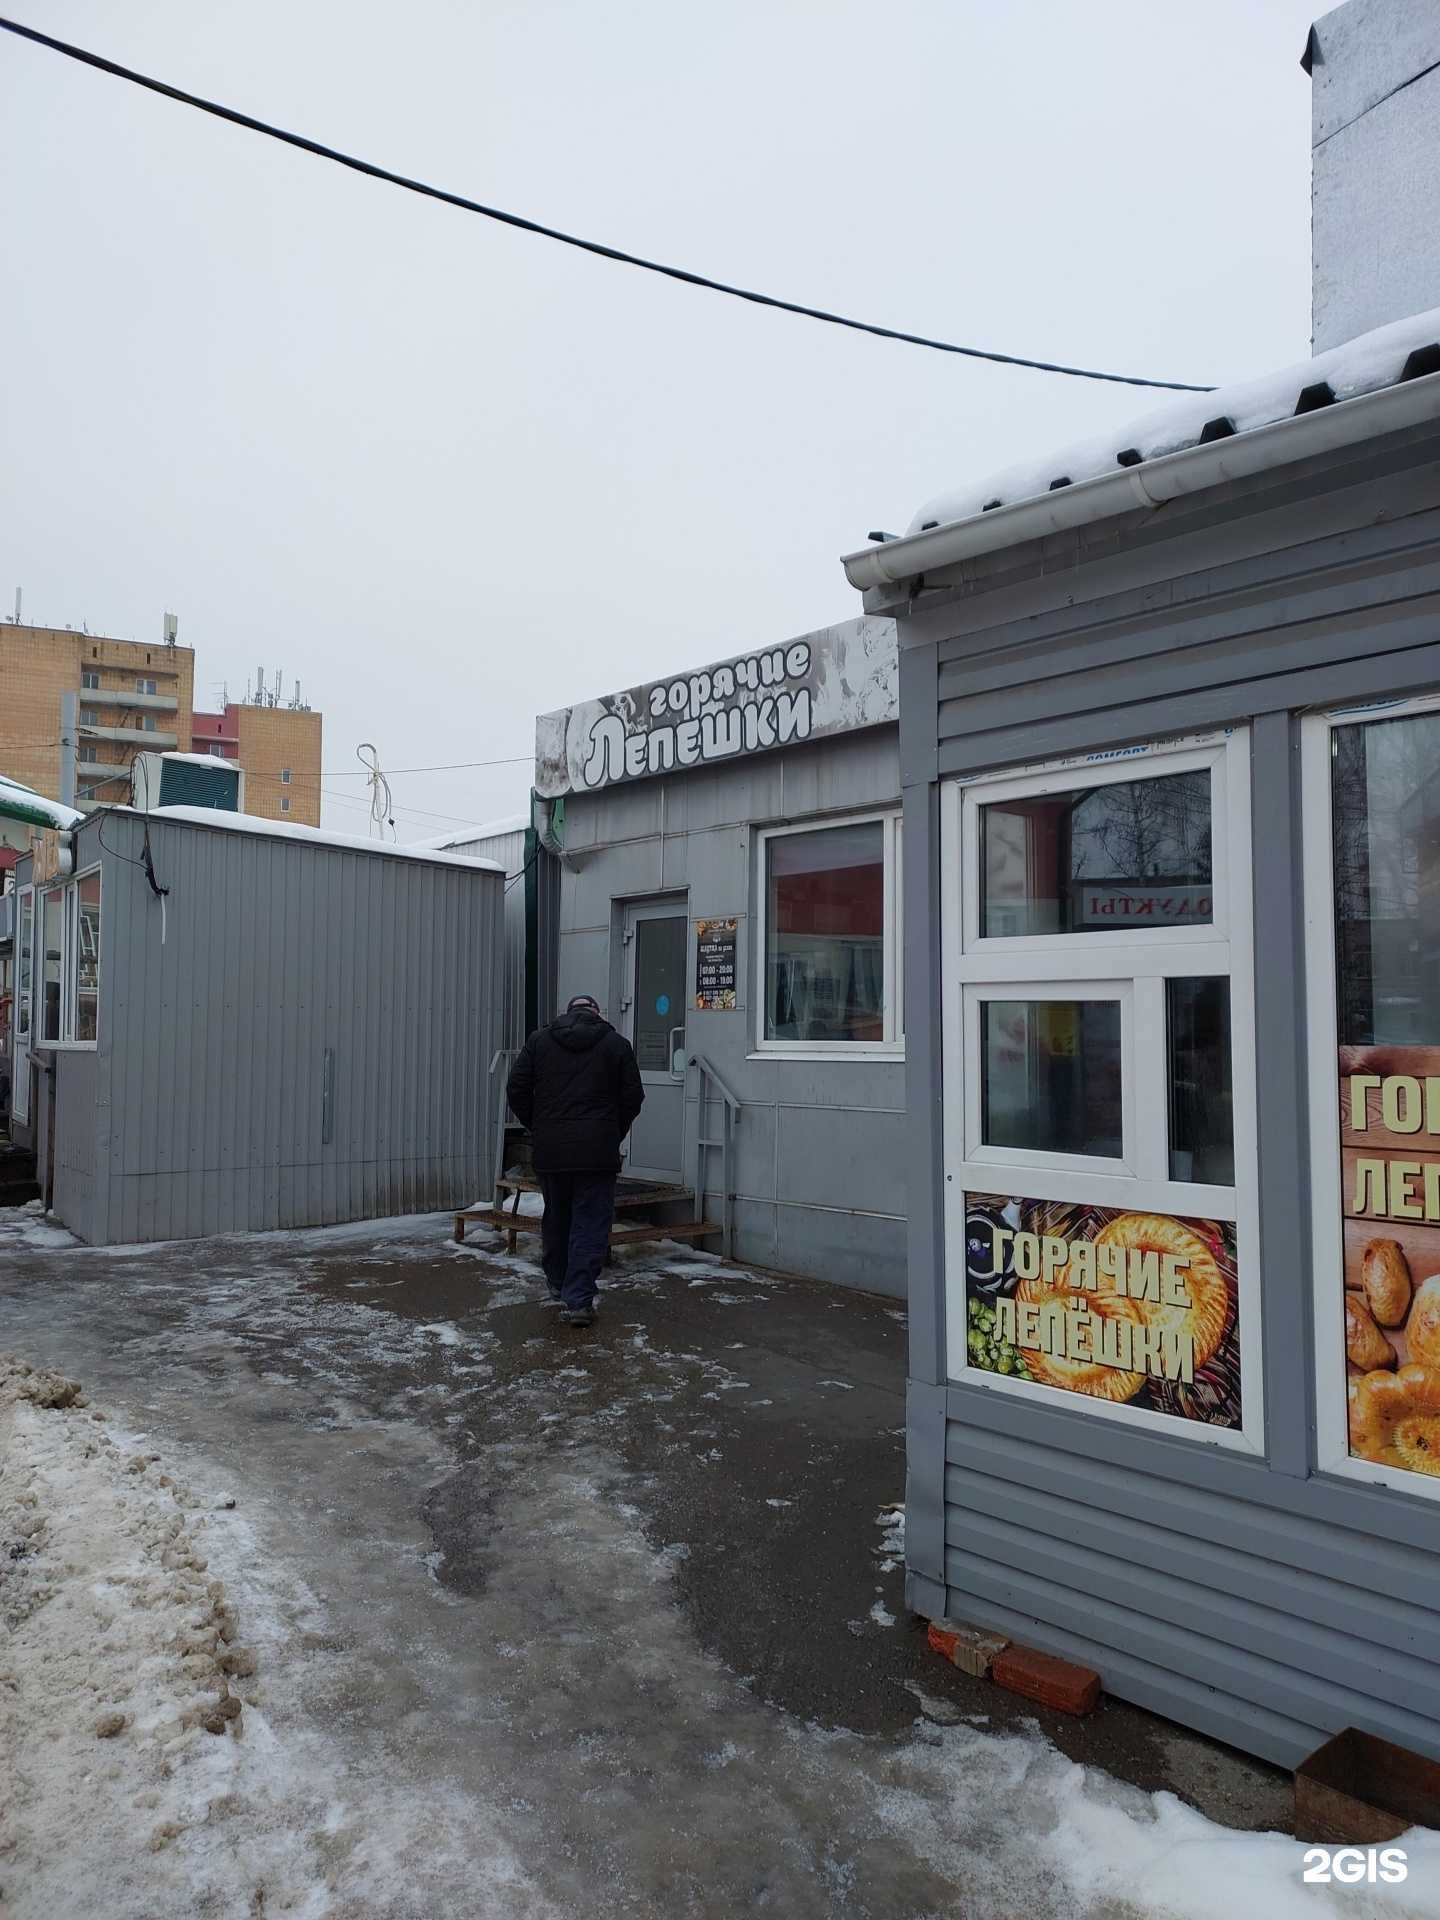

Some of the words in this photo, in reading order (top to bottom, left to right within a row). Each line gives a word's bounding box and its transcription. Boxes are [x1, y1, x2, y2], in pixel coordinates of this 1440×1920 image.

[650, 642, 811, 717] горячие
[1353, 1158, 1440, 1222] ЛЕ
[992, 1228, 1193, 1309] ГОРЯЧИЕ
[994, 1296, 1195, 1384] ЛЕПЁШКИ
